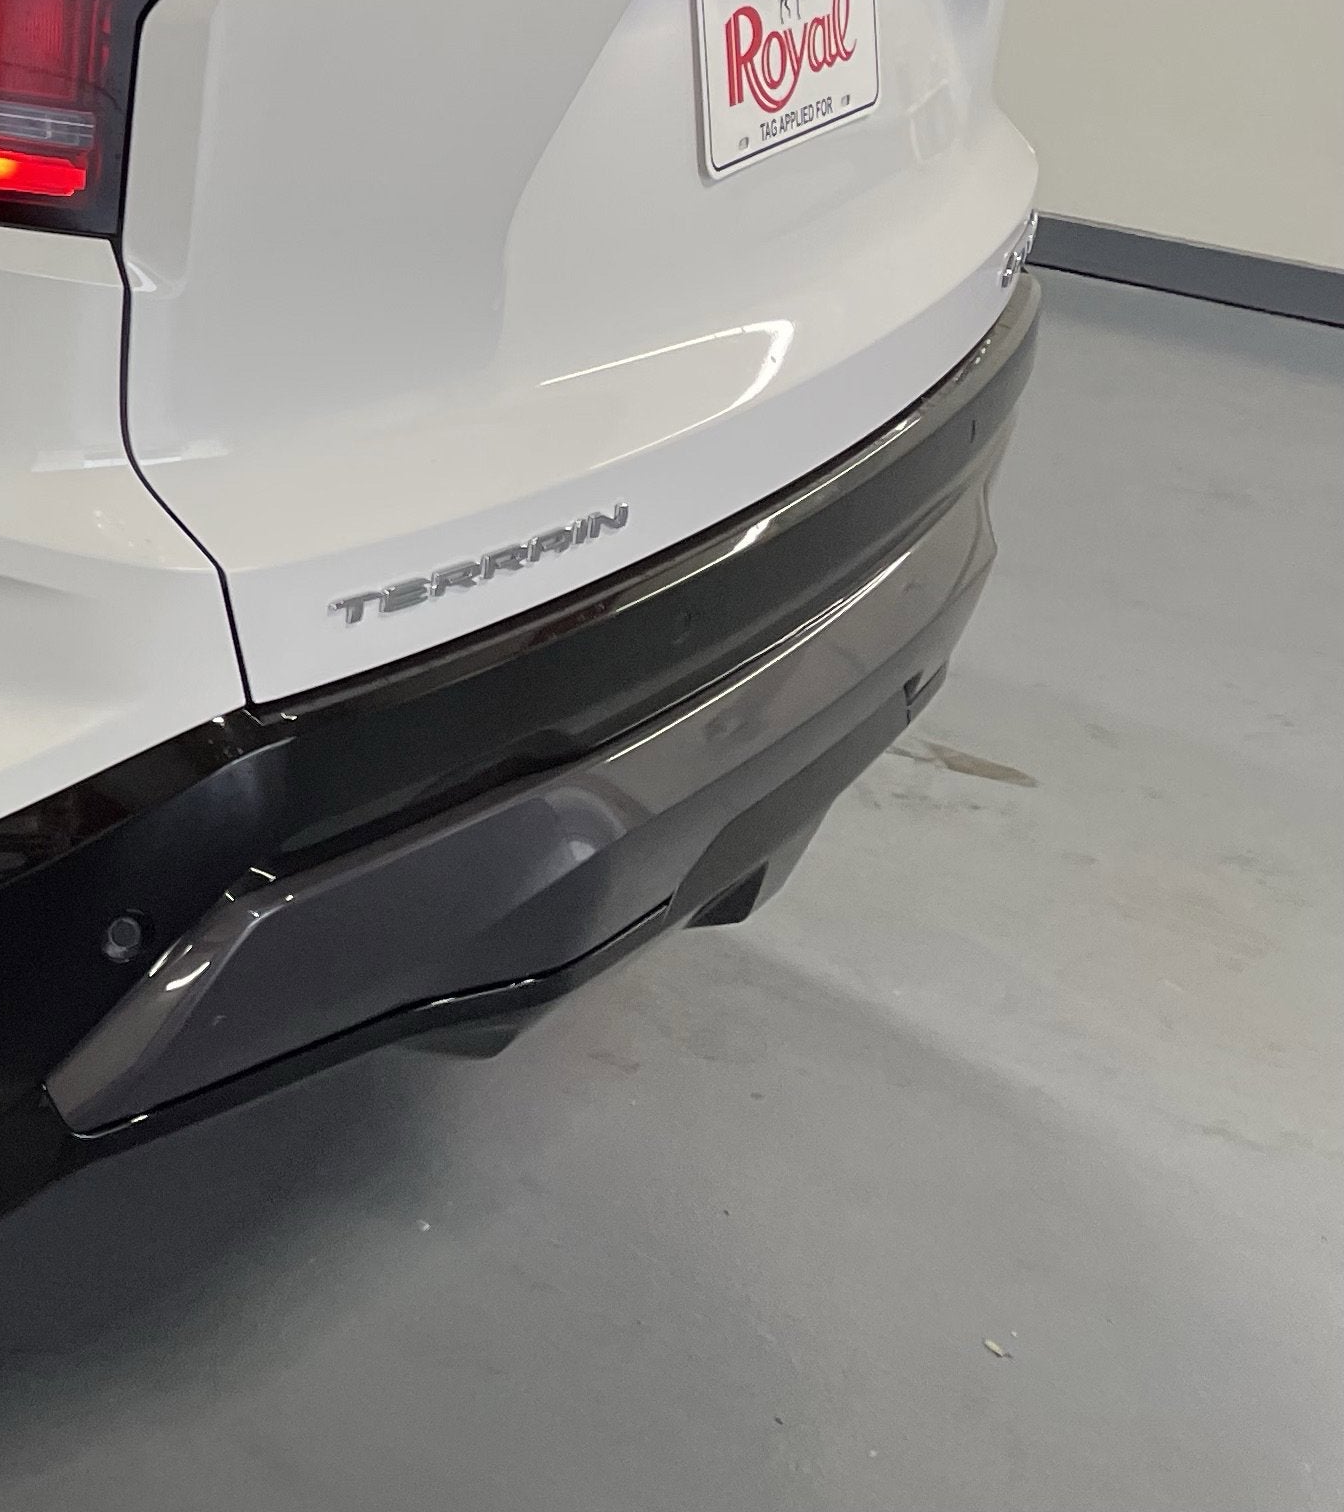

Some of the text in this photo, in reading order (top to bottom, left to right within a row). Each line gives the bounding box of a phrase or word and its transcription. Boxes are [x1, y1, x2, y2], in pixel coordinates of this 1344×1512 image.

[759, 95, 834, 142] TAG APPLIED FOR
[327, 501, 629, 624] TERRAIN
